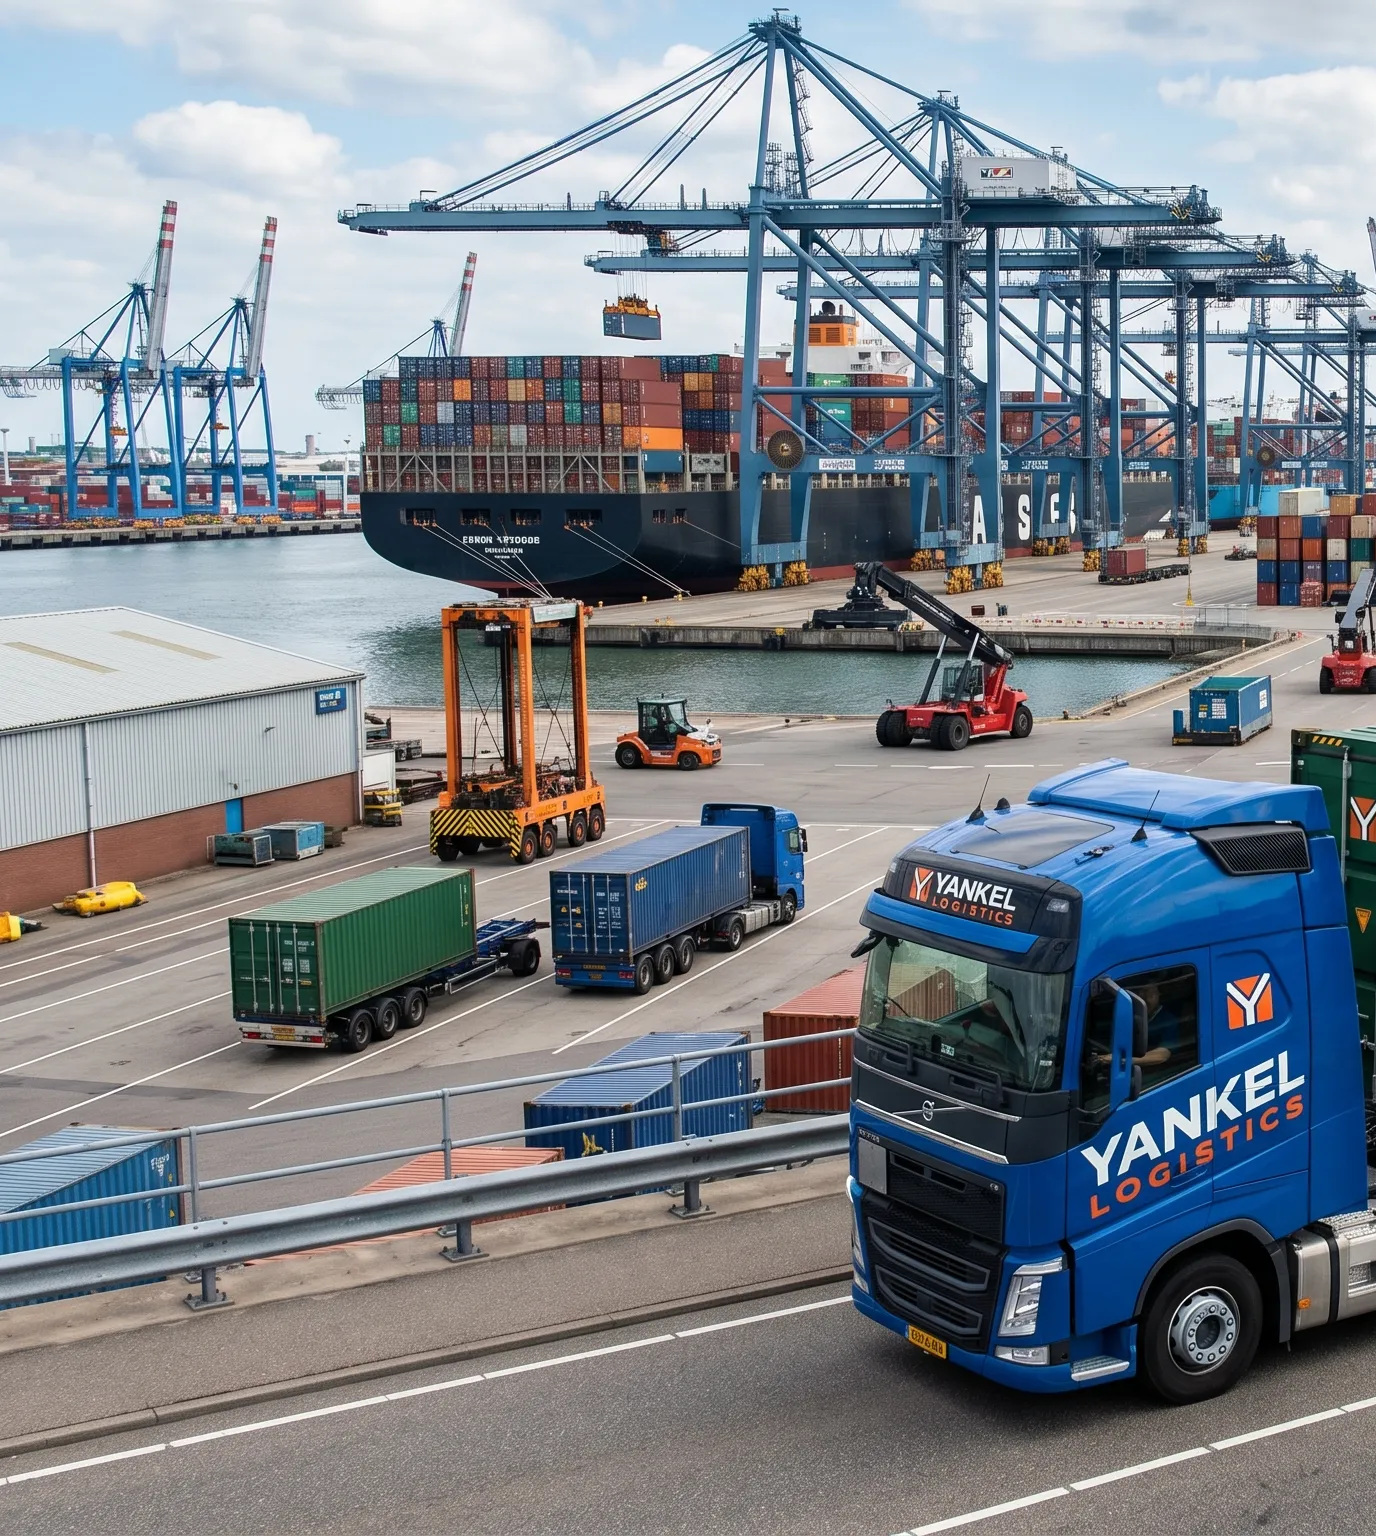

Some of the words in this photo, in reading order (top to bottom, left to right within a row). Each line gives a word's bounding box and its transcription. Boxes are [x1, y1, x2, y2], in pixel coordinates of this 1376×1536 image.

[931, 896, 1013, 925] LOGISTICS
[936, 872, 1016, 911] YANKEL
[1080, 1050, 1305, 1187] YANKEL
[1090, 1094, 1304, 1219] LOGISTICS
